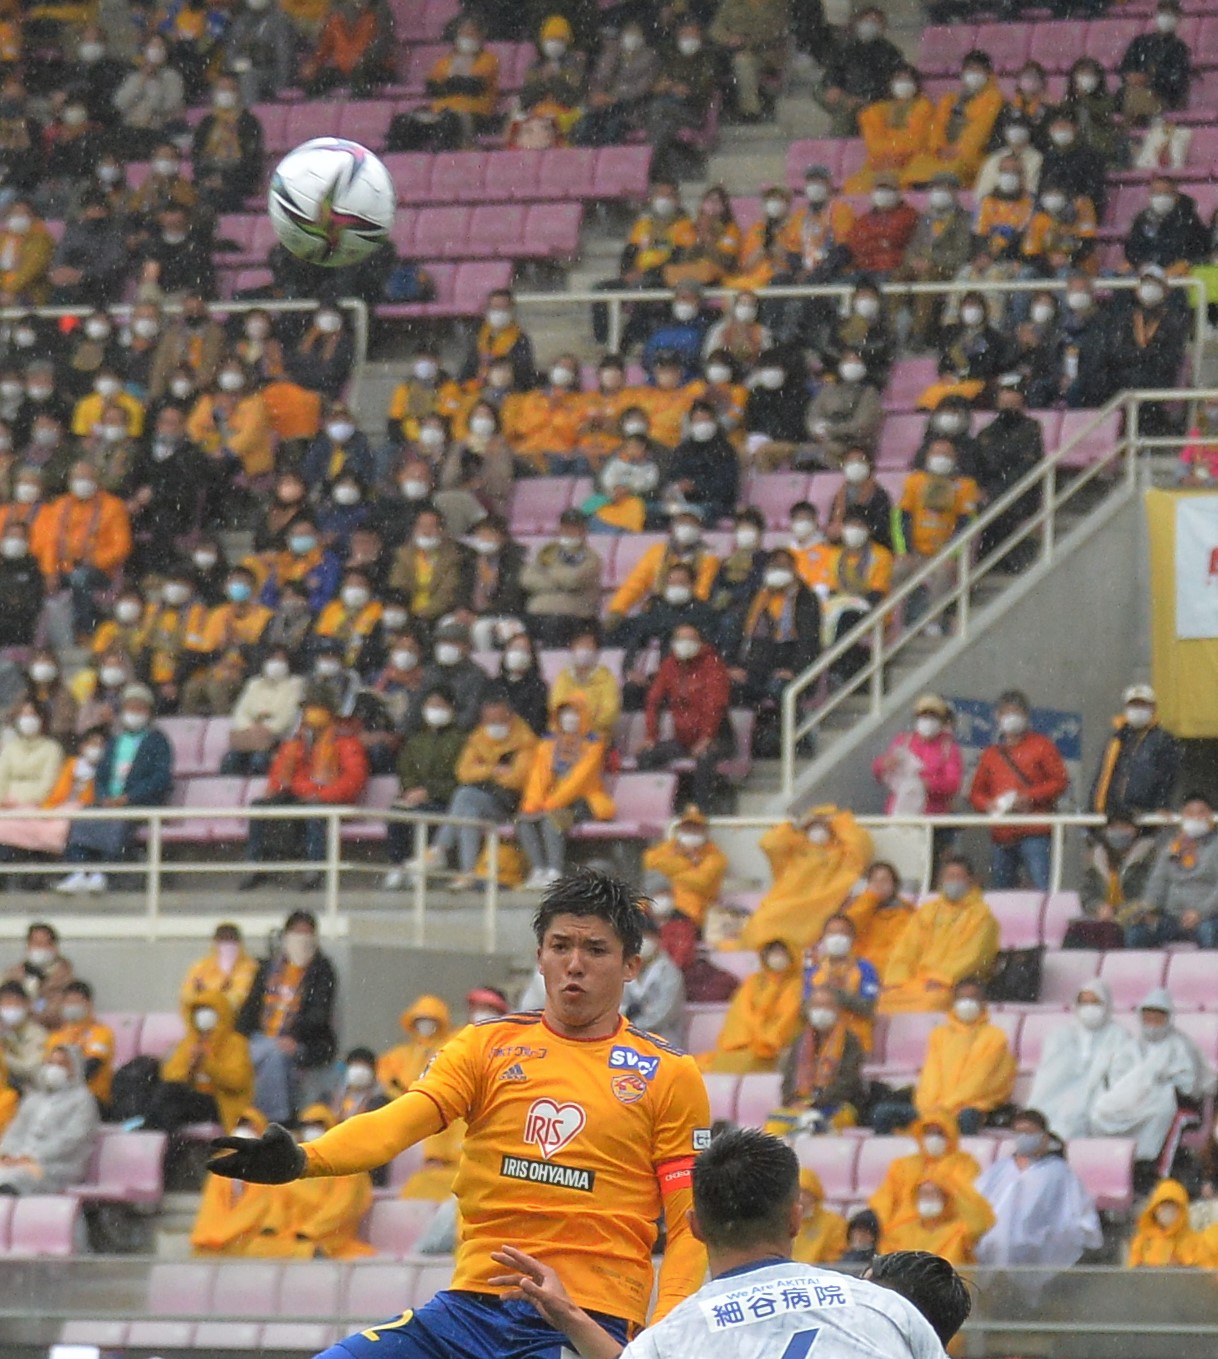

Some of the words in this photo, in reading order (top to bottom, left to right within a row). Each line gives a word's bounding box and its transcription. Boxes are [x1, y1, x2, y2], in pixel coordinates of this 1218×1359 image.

[502, 1157, 529, 1178] IRIS
[529, 1162, 589, 1190] OHYAMA
[711, 1285, 847, 1327] 細谷病院
[726, 1291, 748, 1301] We
[751, 1284, 774, 1295] Are
